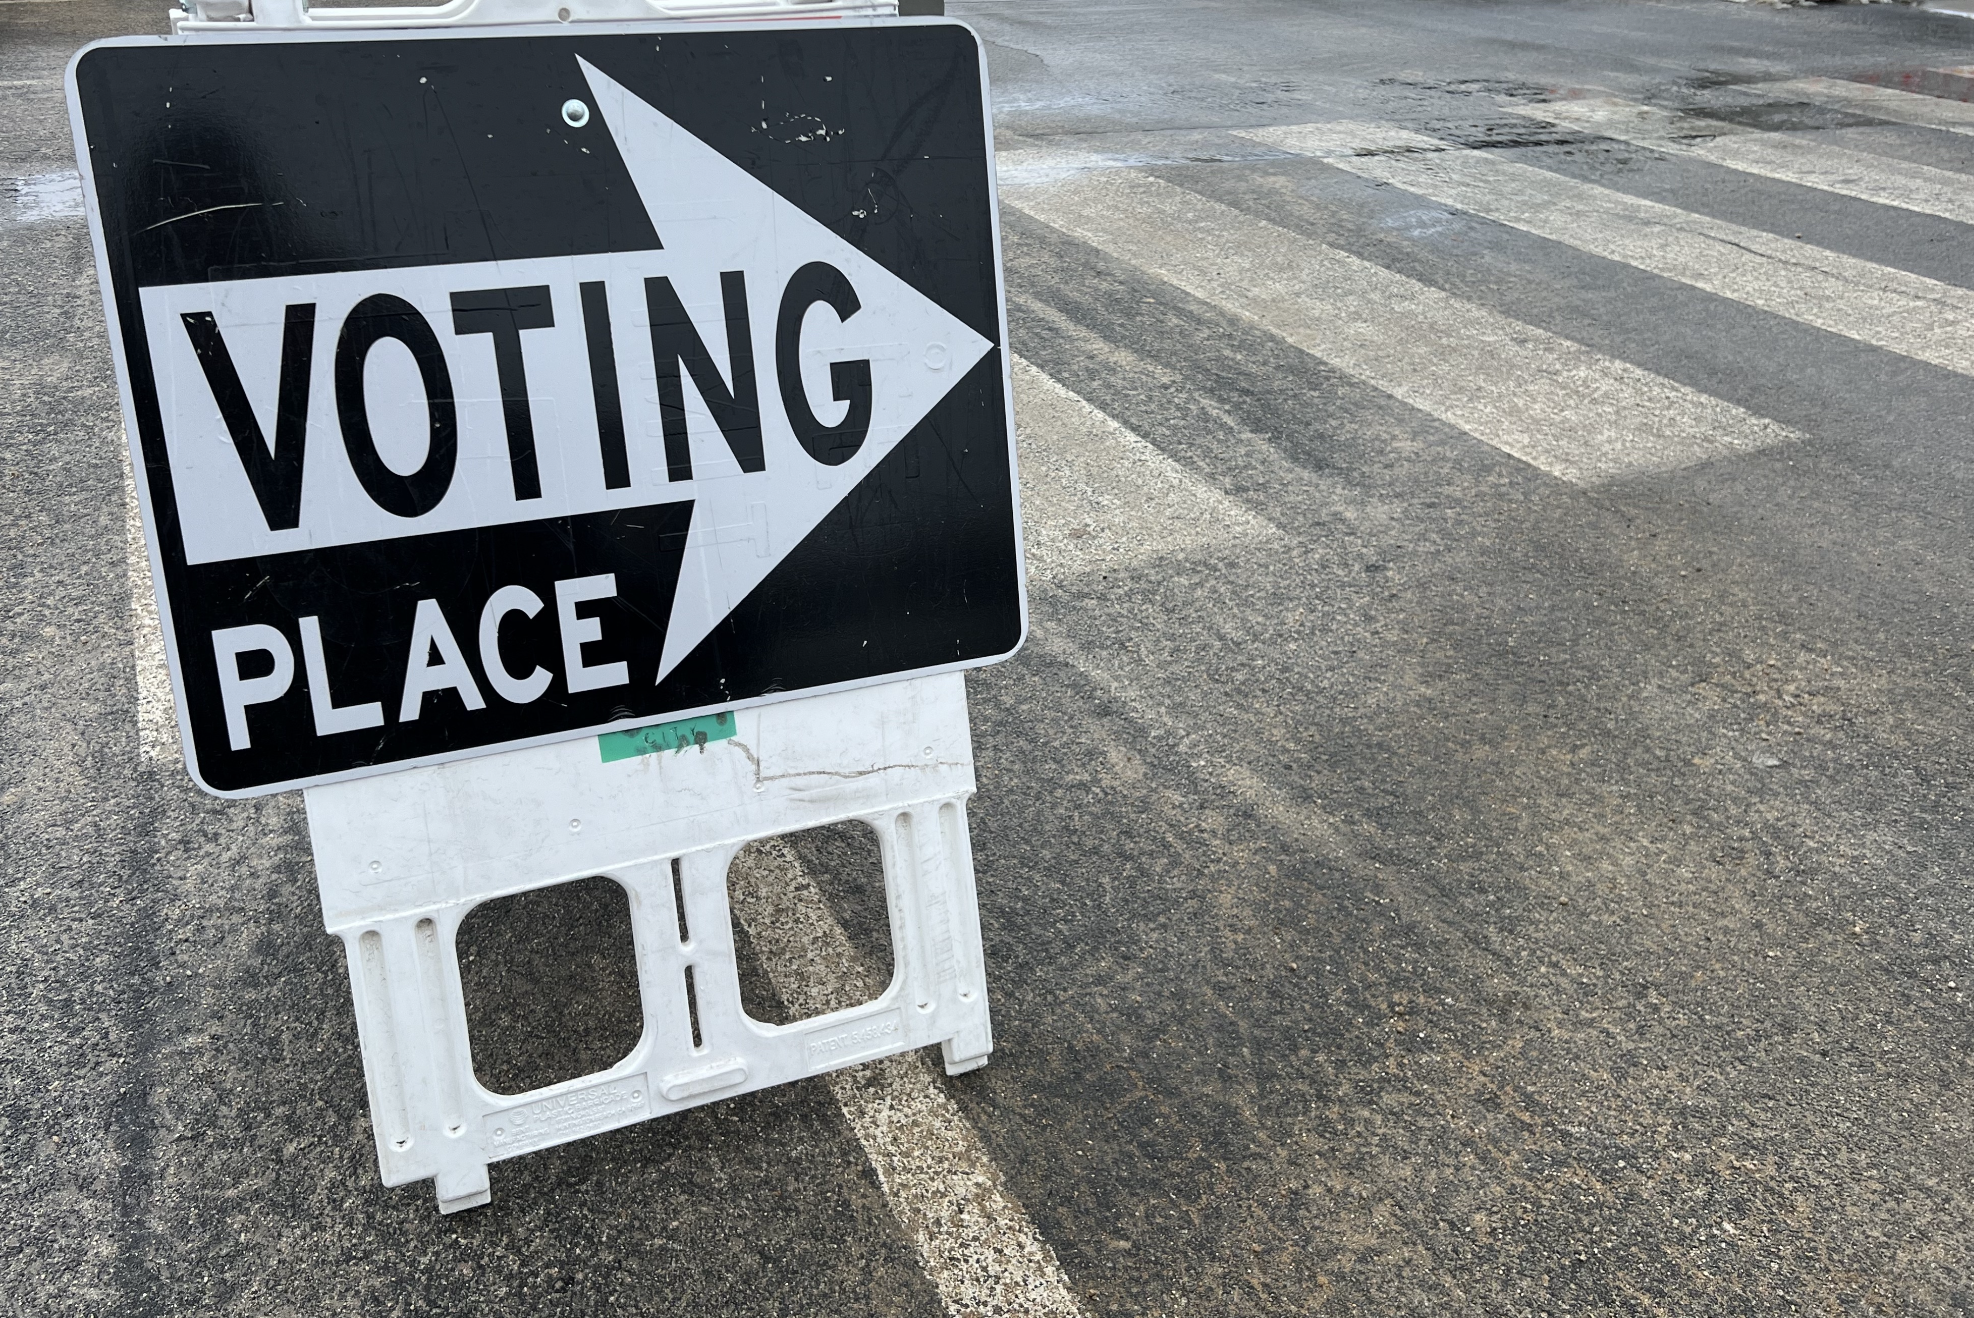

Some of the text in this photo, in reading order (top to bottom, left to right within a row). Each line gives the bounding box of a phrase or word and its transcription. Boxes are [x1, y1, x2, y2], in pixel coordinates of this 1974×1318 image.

[180, 260, 874, 532] VOTING
[211, 573, 629, 751] PLACE
[810, 1034, 848, 1055] PATENT
[531, 1085, 617, 1114] UNIVERSAL
[533, 1107, 573, 1122] PLASTIC
[574, 1091, 628, 1111] BARRICADE
